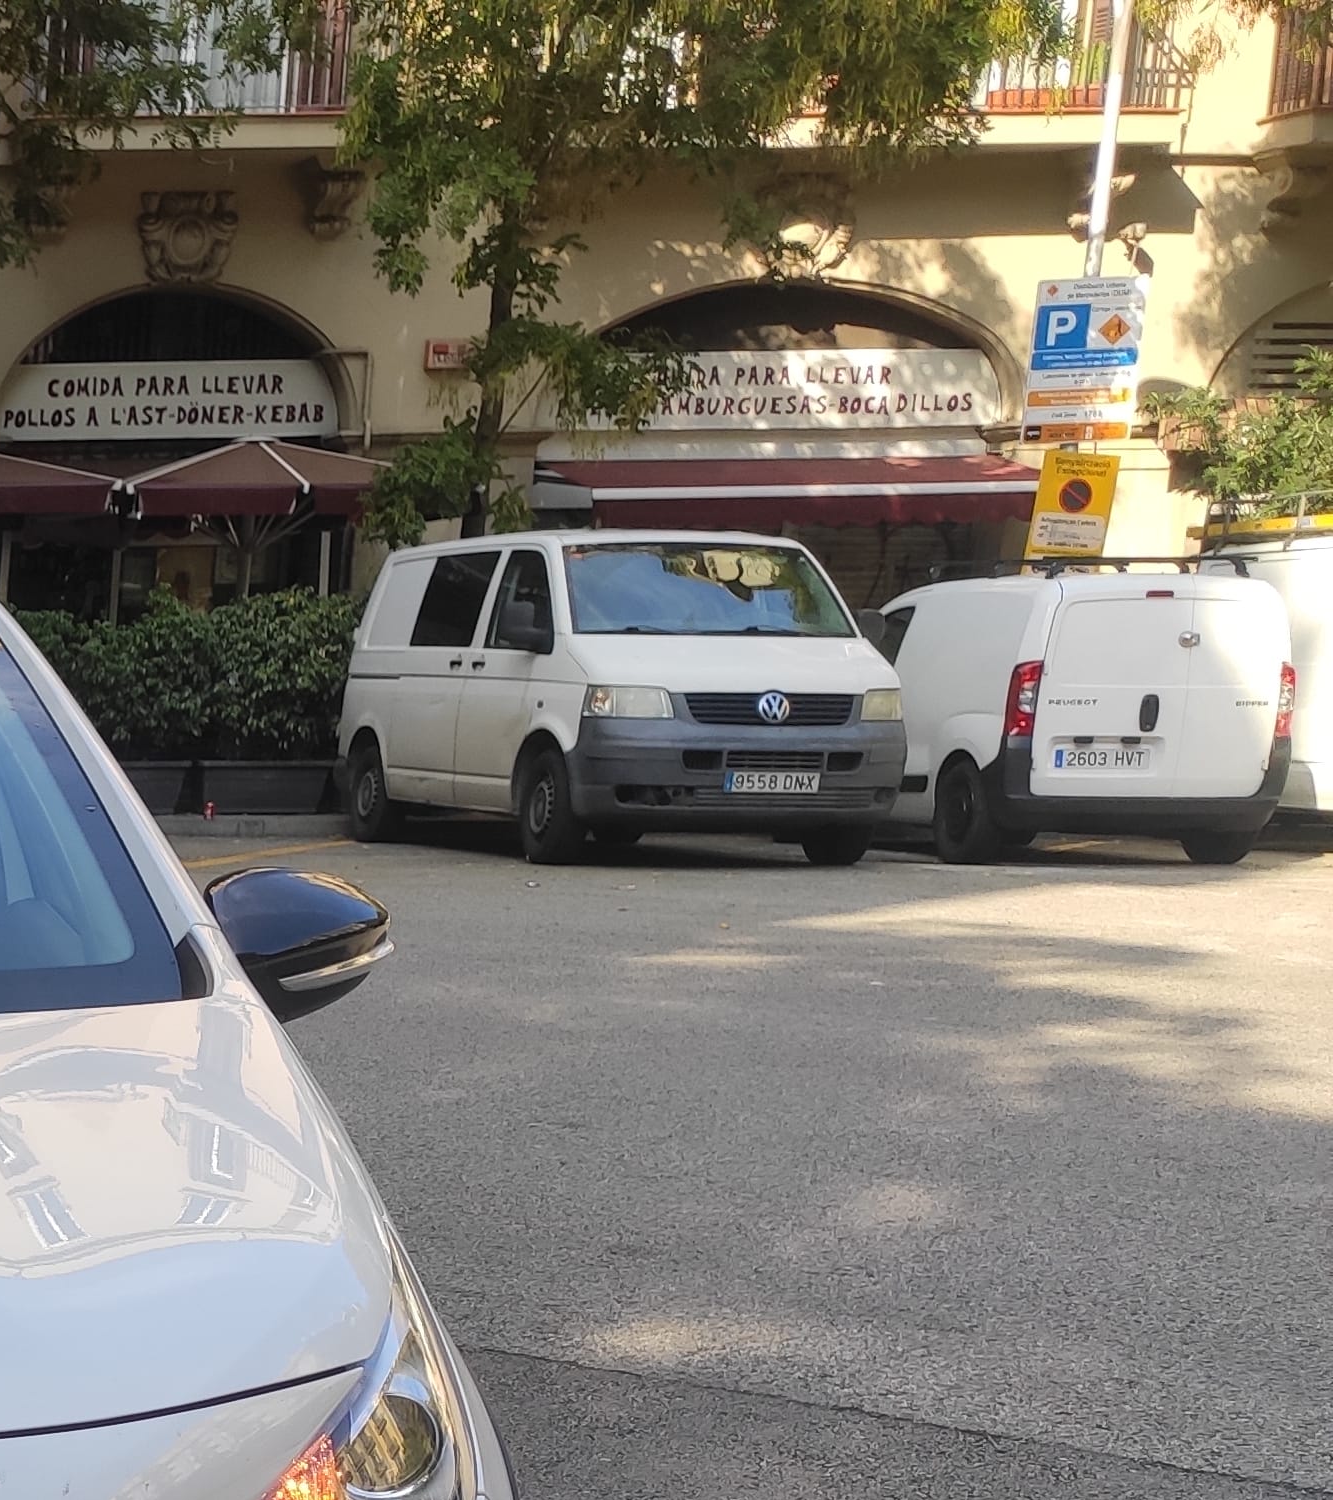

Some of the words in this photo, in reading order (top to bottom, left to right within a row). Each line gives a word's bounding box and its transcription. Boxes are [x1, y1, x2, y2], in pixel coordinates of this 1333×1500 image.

[1046, 310, 1077, 347] P
[47, 377, 124, 398] COMIDA
[135, 375, 190, 396] PARA
[202, 373, 284, 395] LLEVAR
[734, 365, 791, 386] PARA
[806, 364, 892, 385] LLEVAR
[4, 406, 76, 428] POLLOS
[86, 406, 99, 427] A
[1048, 698, 1099, 706] PEUGEOT
[1066, 751, 1108, 767] 2603
[1114, 751, 1145, 767] HVT
[734, 774, 778, 790] 9558
[782, 774, 815, 790] DNX
